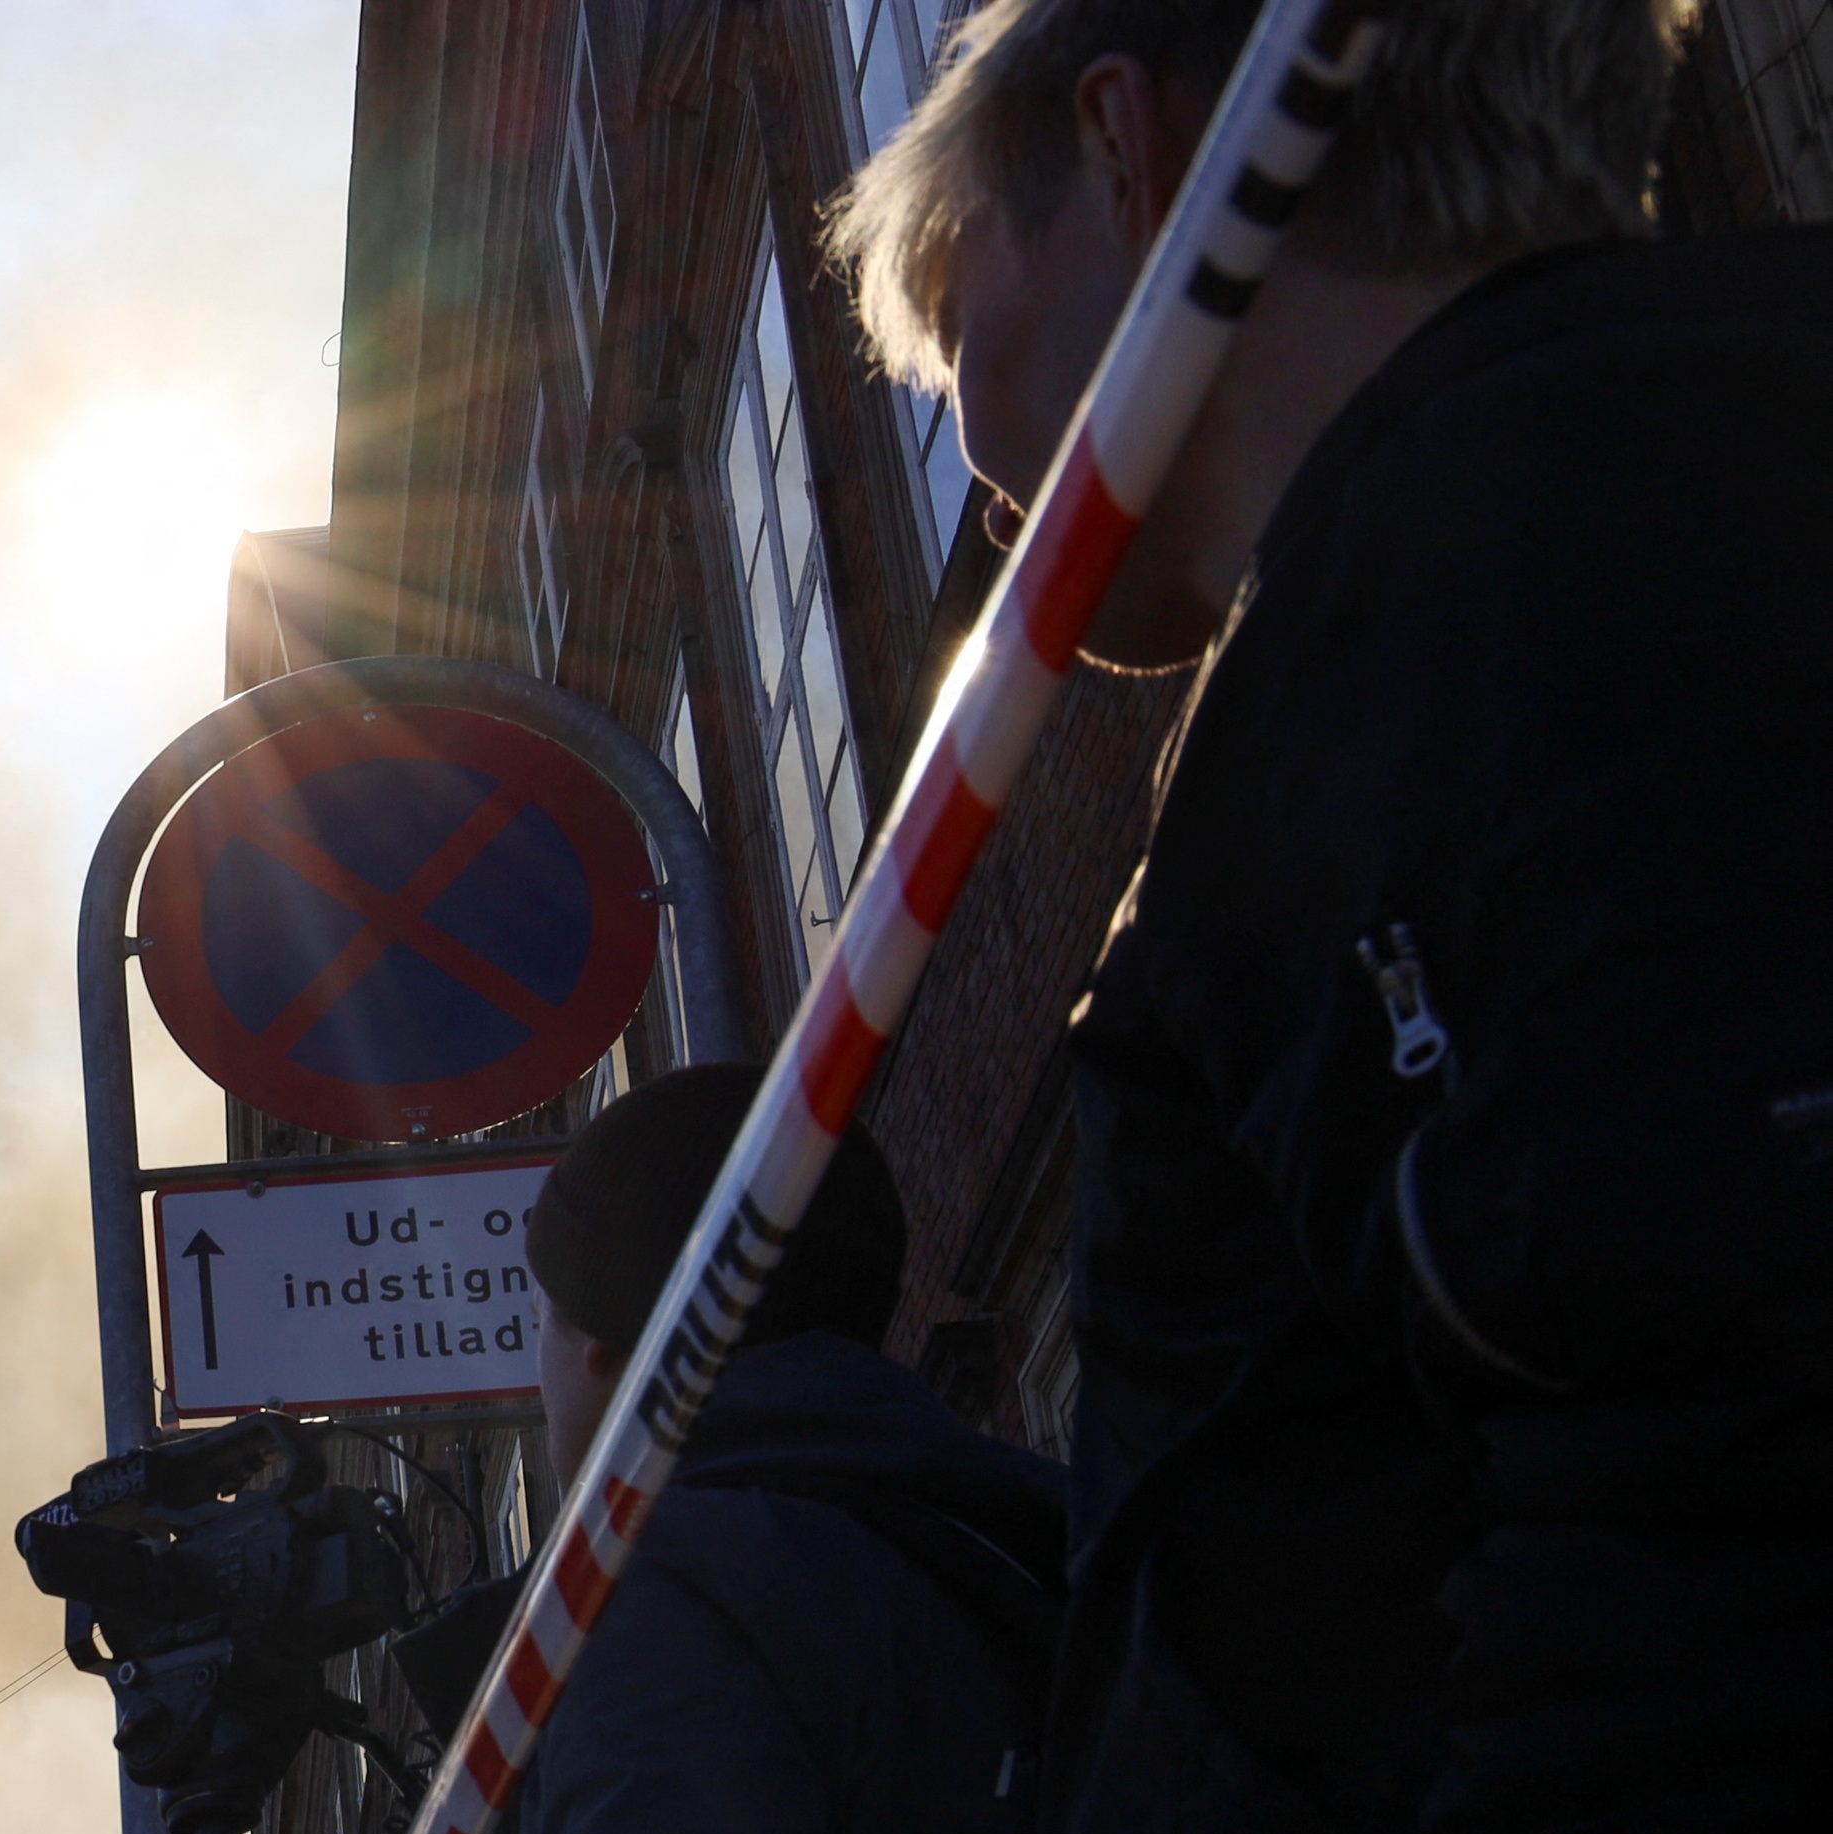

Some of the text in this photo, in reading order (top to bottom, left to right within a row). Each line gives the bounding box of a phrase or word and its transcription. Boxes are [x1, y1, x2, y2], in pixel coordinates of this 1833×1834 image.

[345, 1207, 444, 1247] Ud-
[283, 1262, 529, 1309] indstign
[363, 1315, 540, 1361] tillad
